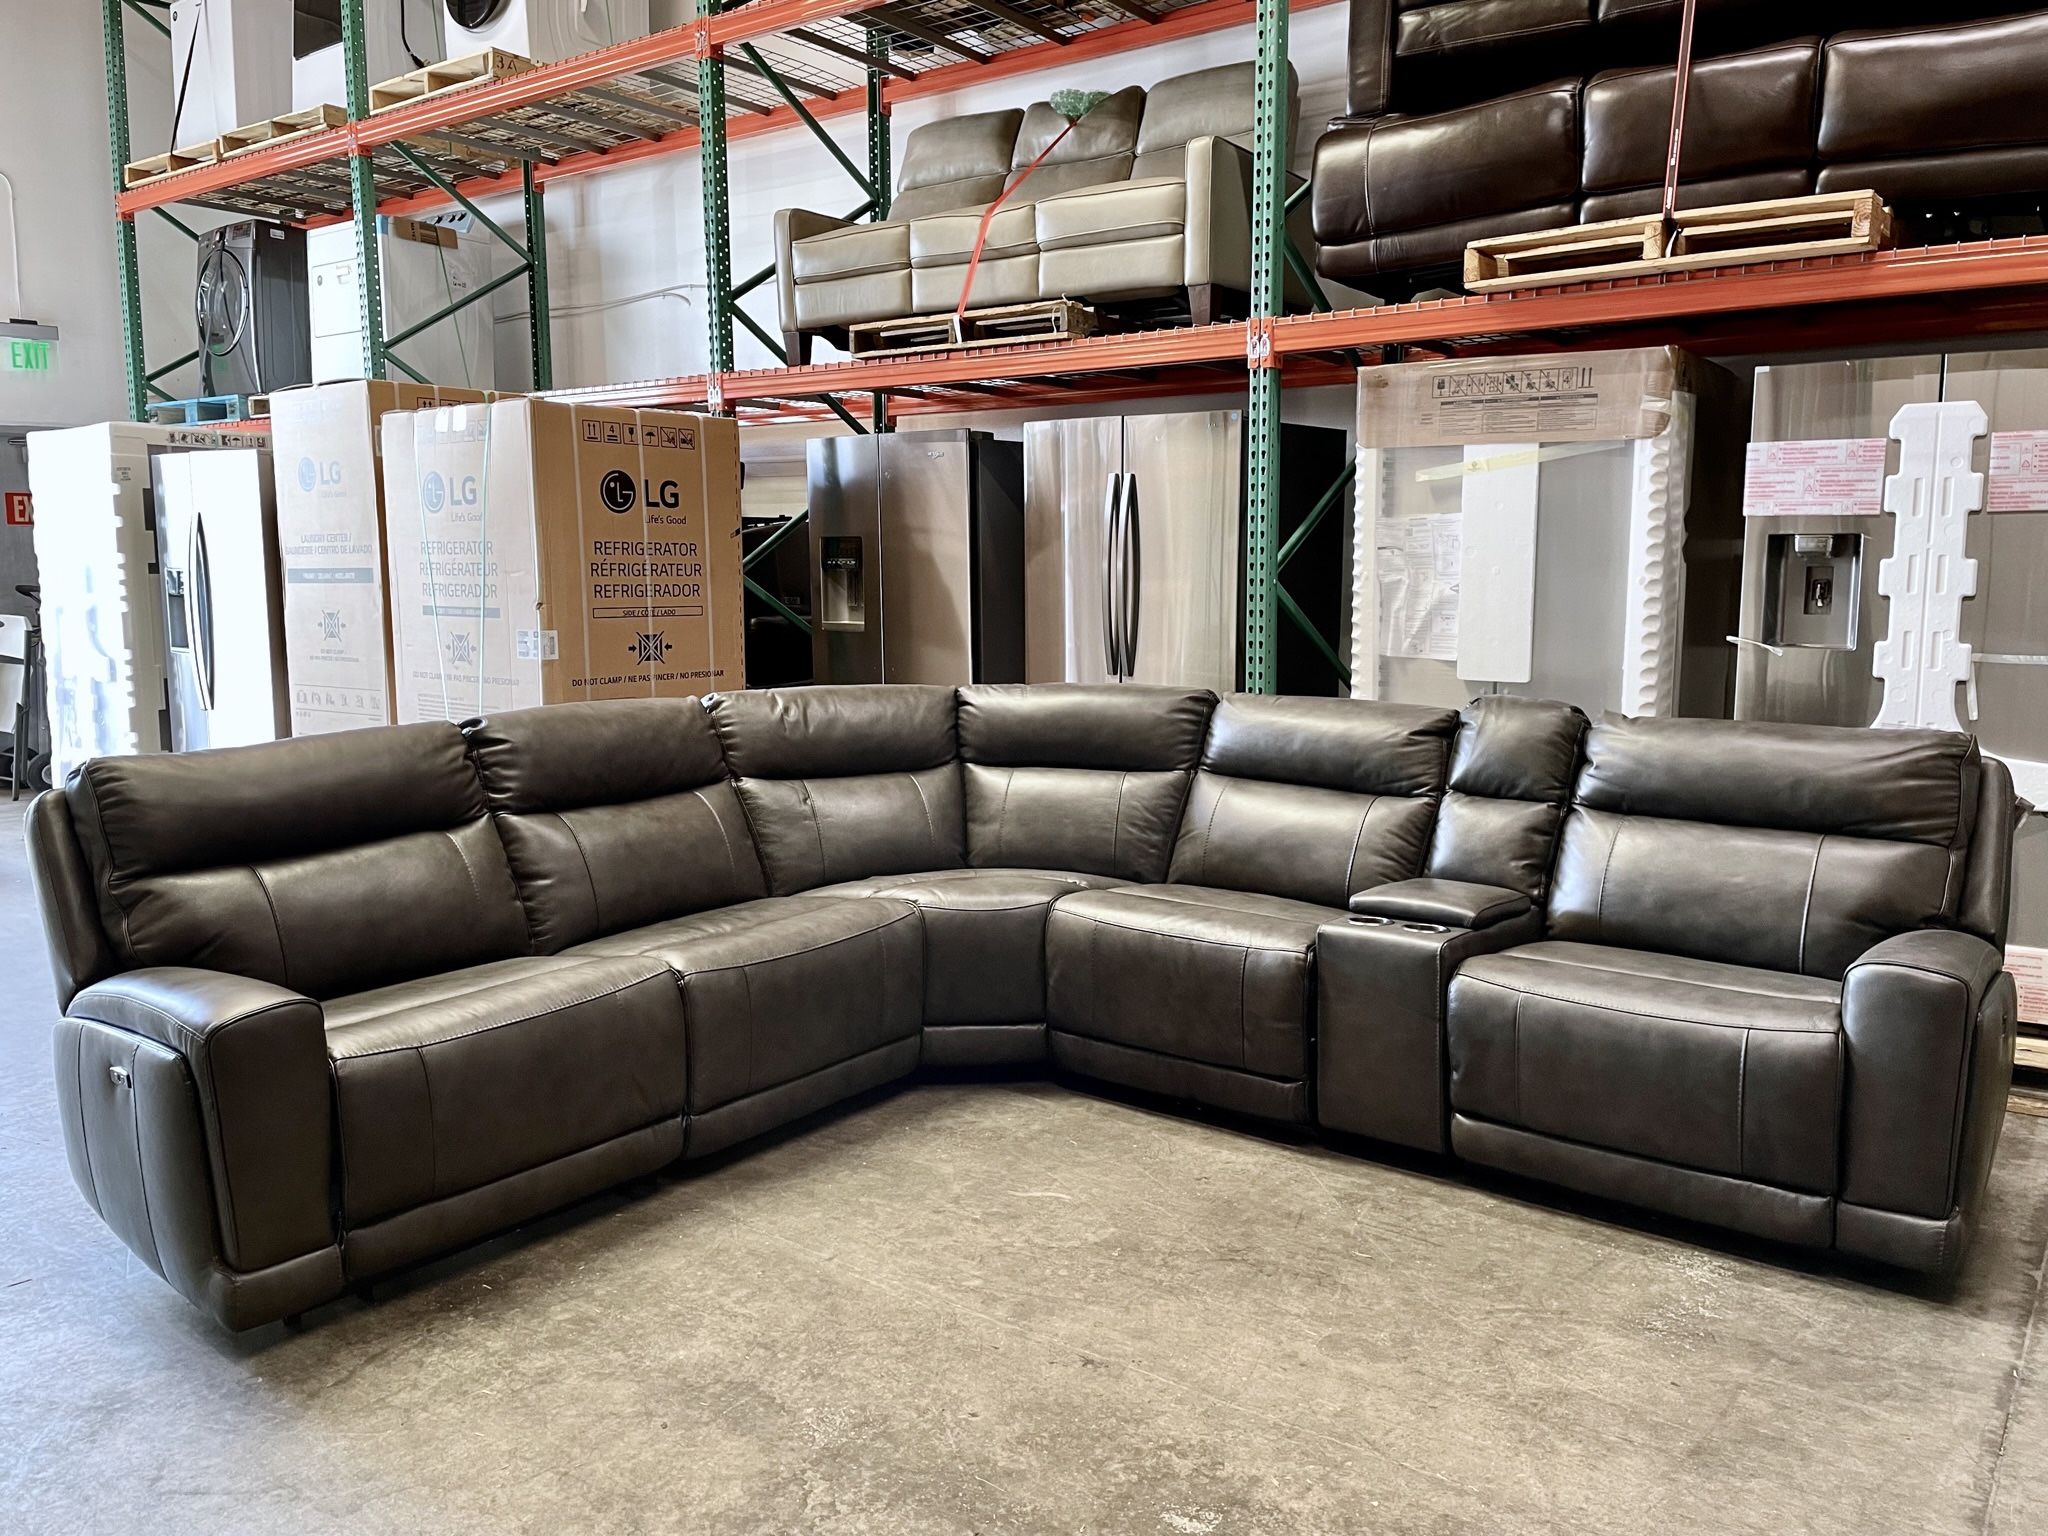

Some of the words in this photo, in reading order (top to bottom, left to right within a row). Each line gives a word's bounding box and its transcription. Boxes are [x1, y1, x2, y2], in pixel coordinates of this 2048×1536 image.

[11, 341, 49, 369] EXIT
[319, 461, 342, 485] LG
[449, 475, 477, 506] LG
[644, 479, 680, 508] LG
[13, 495, 34, 522] EX
[666, 515, 687, 525] Good
[420, 541, 494, 556] REFRIGERATOR
[594, 541, 698, 557] REFRIGERATOR
[590, 559, 702, 578] RÉFRIGÉRATEUR
[593, 584, 701, 599] REFRIGERADOR
[572, 679, 583, 687] DO
[599, 676, 623, 685] CLAMP
[628, 675, 637, 683] NE
[639, 673, 651, 682] PAS
[651, 672, 675, 681] INCER
[680, 671, 689, 680] NO
